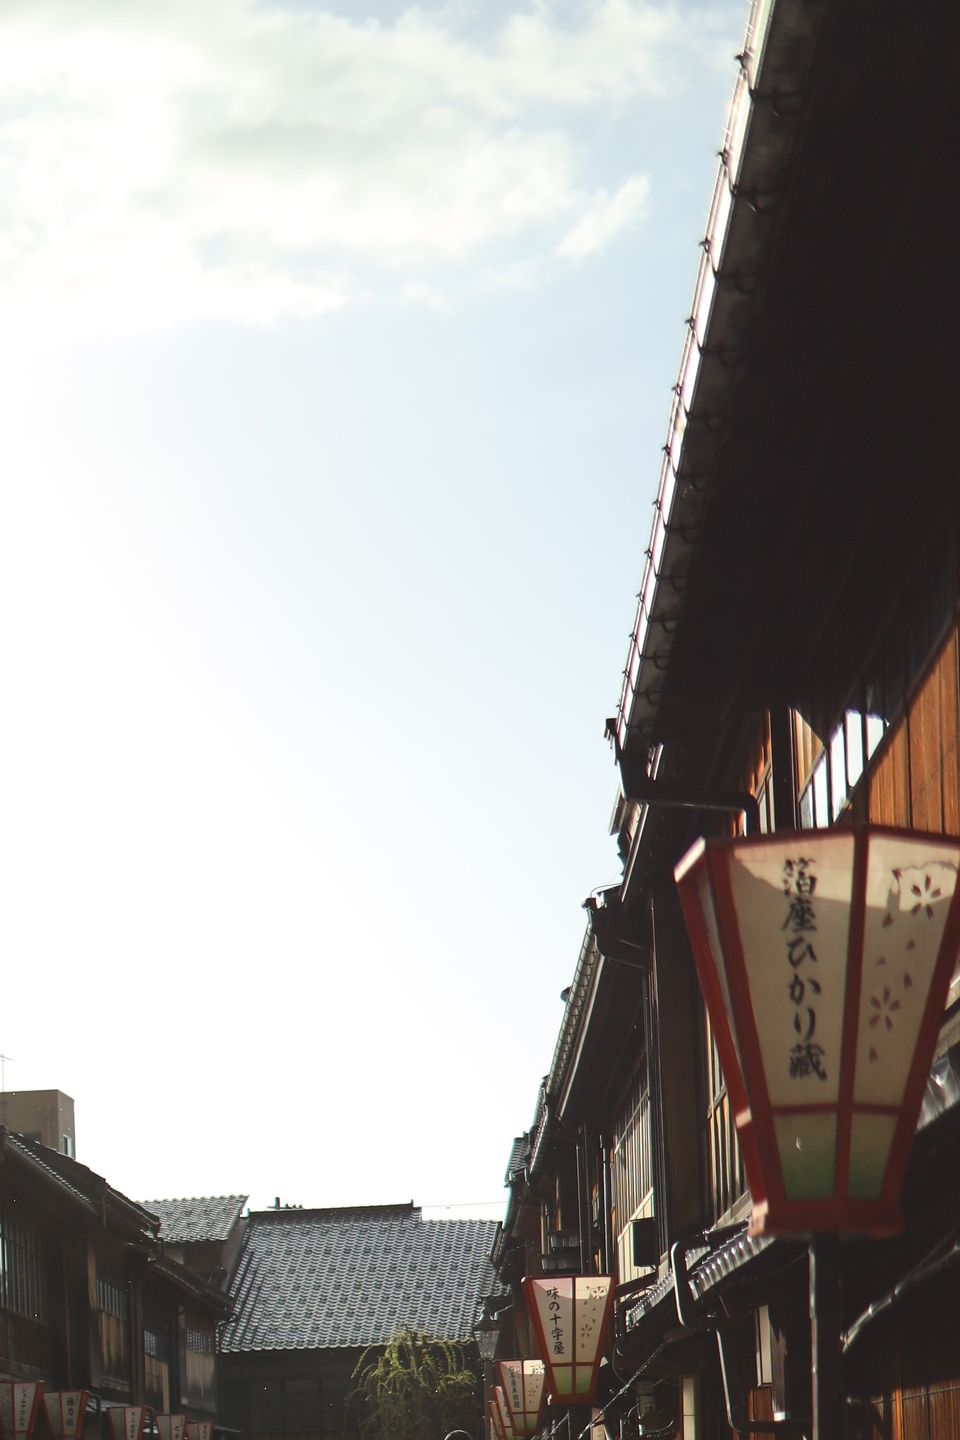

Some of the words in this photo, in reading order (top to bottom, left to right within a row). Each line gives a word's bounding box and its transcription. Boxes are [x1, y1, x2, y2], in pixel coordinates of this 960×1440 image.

[781, 858, 827, 1081] 箔座ひかり蔵
[546, 1286, 566, 1355] 味の十字屋
